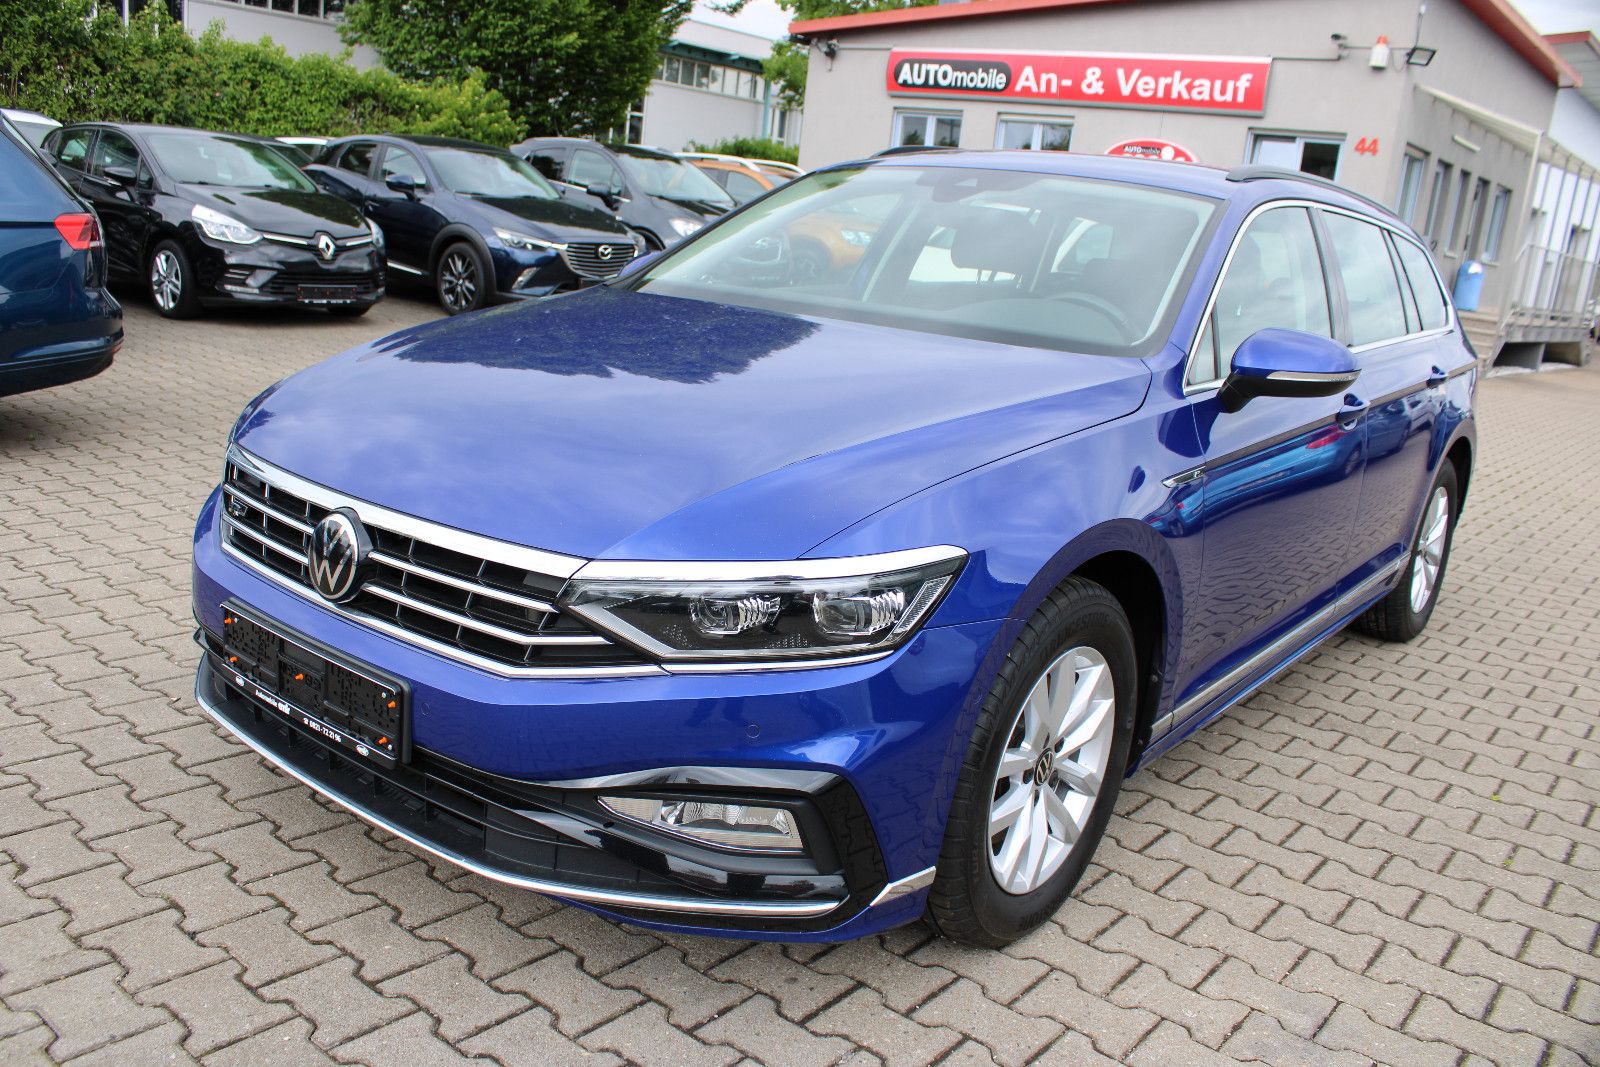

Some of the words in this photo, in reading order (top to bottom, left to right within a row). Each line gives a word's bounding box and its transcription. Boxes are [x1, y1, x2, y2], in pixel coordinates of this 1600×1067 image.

[897, 63, 1007, 90] AUTOmobile
[1014, 66, 1073, 93] An-
[1080, 66, 1105, 95] &
[1116, 67, 1254, 104] Verkauf
[1354, 137, 1378, 156] 44
